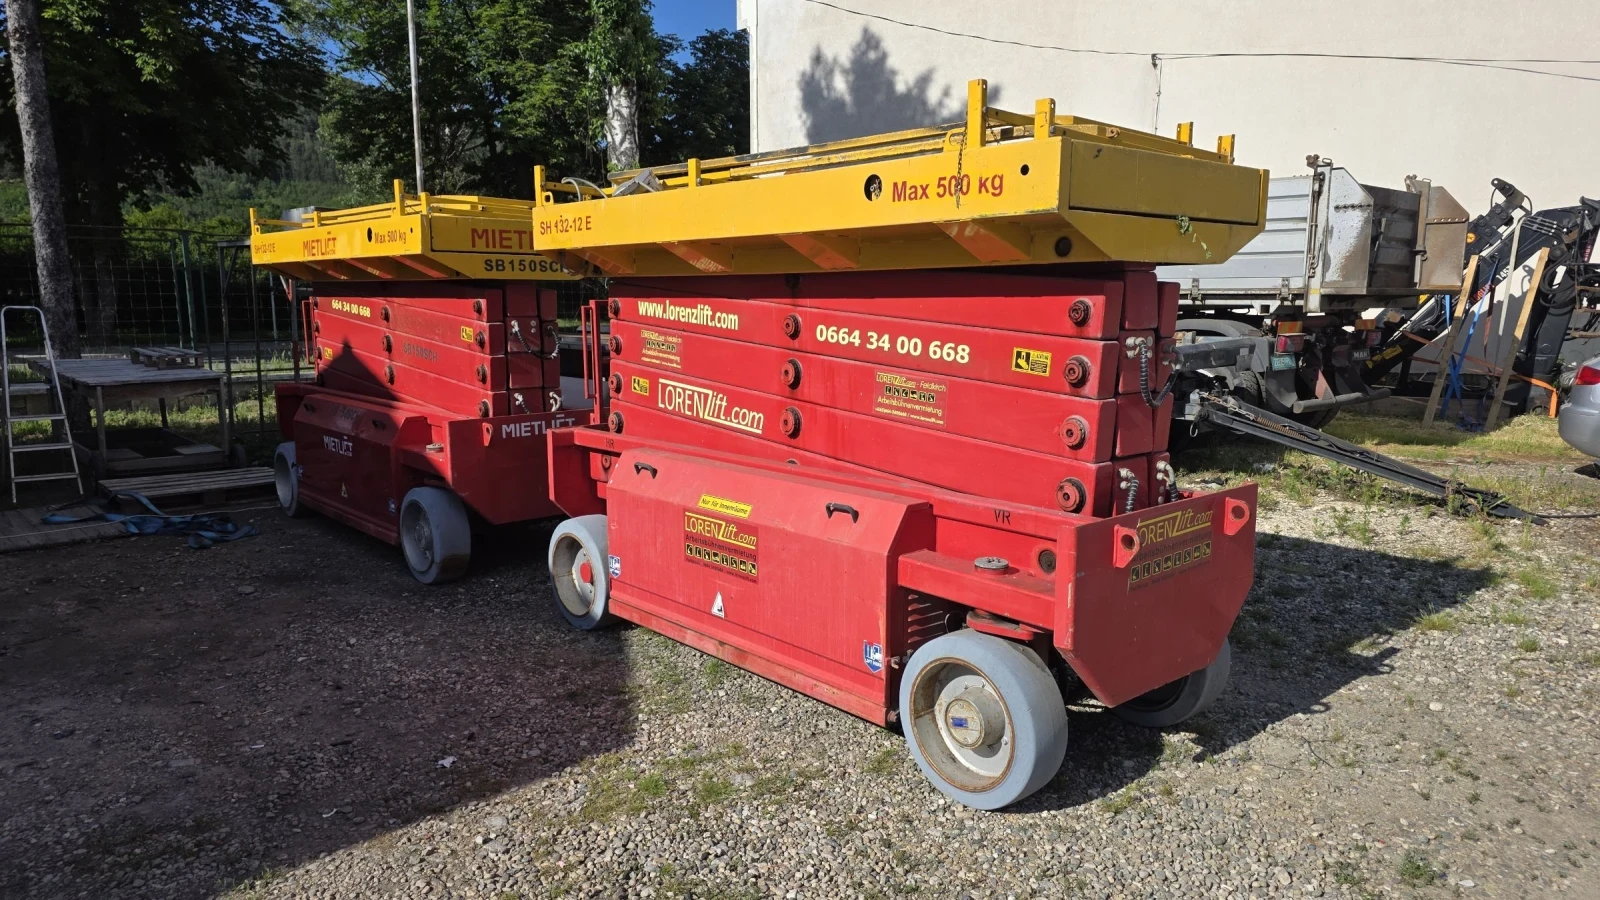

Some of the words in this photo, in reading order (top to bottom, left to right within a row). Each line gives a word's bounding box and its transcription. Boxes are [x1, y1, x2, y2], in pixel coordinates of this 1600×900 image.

[892, 181, 930, 202] Max
[936, 174, 971, 198] 500
[978, 173, 1004, 197] kg
[540, 220, 552, 235] SH
[554, 216, 583, 234] 132-12
[585, 215, 592, 231] E
[374, 232, 386, 244] Max
[387, 230, 398, 242] 500
[399, 229, 407, 244] kg
[484, 259, 563, 273] SB150SC
[331, 299, 343, 310] 664
[342, 303, 350, 313] 34
[351, 304, 359, 315] 00
[359, 305, 371, 318] 668
[638, 300, 739, 330] www.lorenzlift.com
[815, 324, 861, 347] 0664
[866, 331, 890, 351] 34
[896, 335, 922, 356] 00
[928, 340, 970, 364] 668
[605, 438, 615, 450] HR
[701, 498, 709, 506] Nur
[994, 508, 1011, 525] VR
[685, 534, 757, 562] Arbeitsbühnenvermietung
